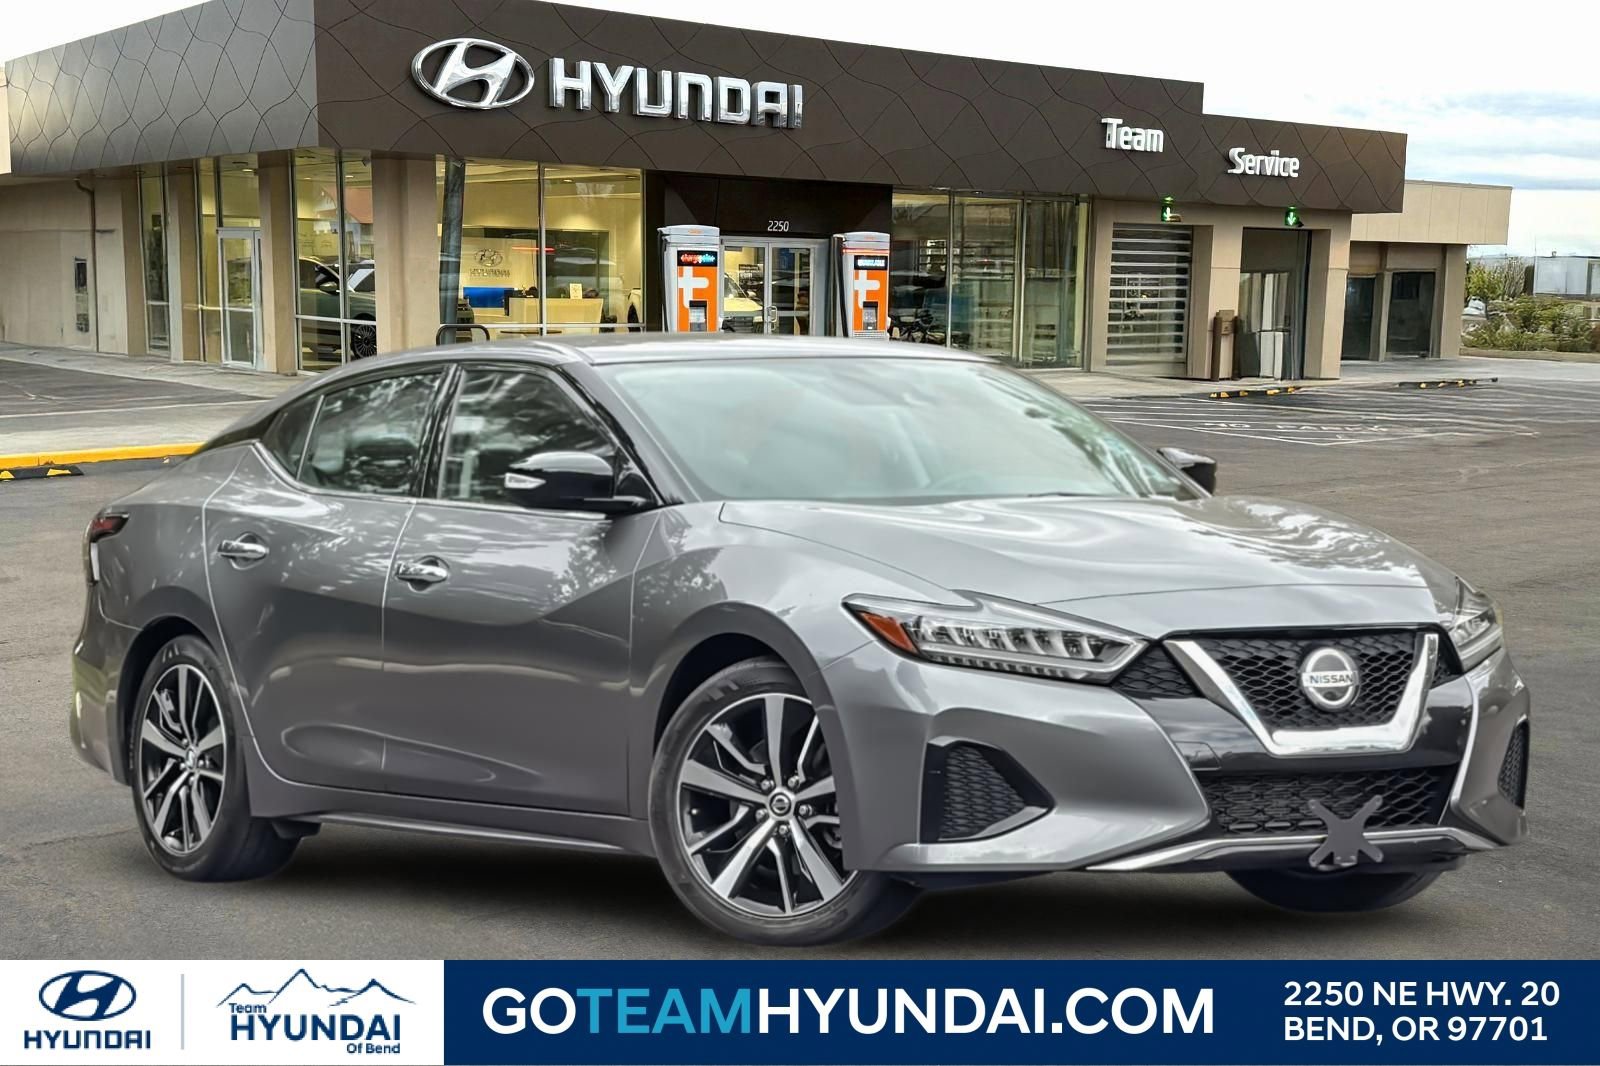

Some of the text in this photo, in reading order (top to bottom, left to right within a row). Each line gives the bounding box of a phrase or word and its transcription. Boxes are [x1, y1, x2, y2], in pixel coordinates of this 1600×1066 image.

[549, 57, 804, 128] HYUNDAI
[1101, 117, 1164, 153] Team
[1227, 147, 1300, 178] Service
[767, 220, 789, 232] 2250
[1309, 674, 1354, 684] NISSAN
